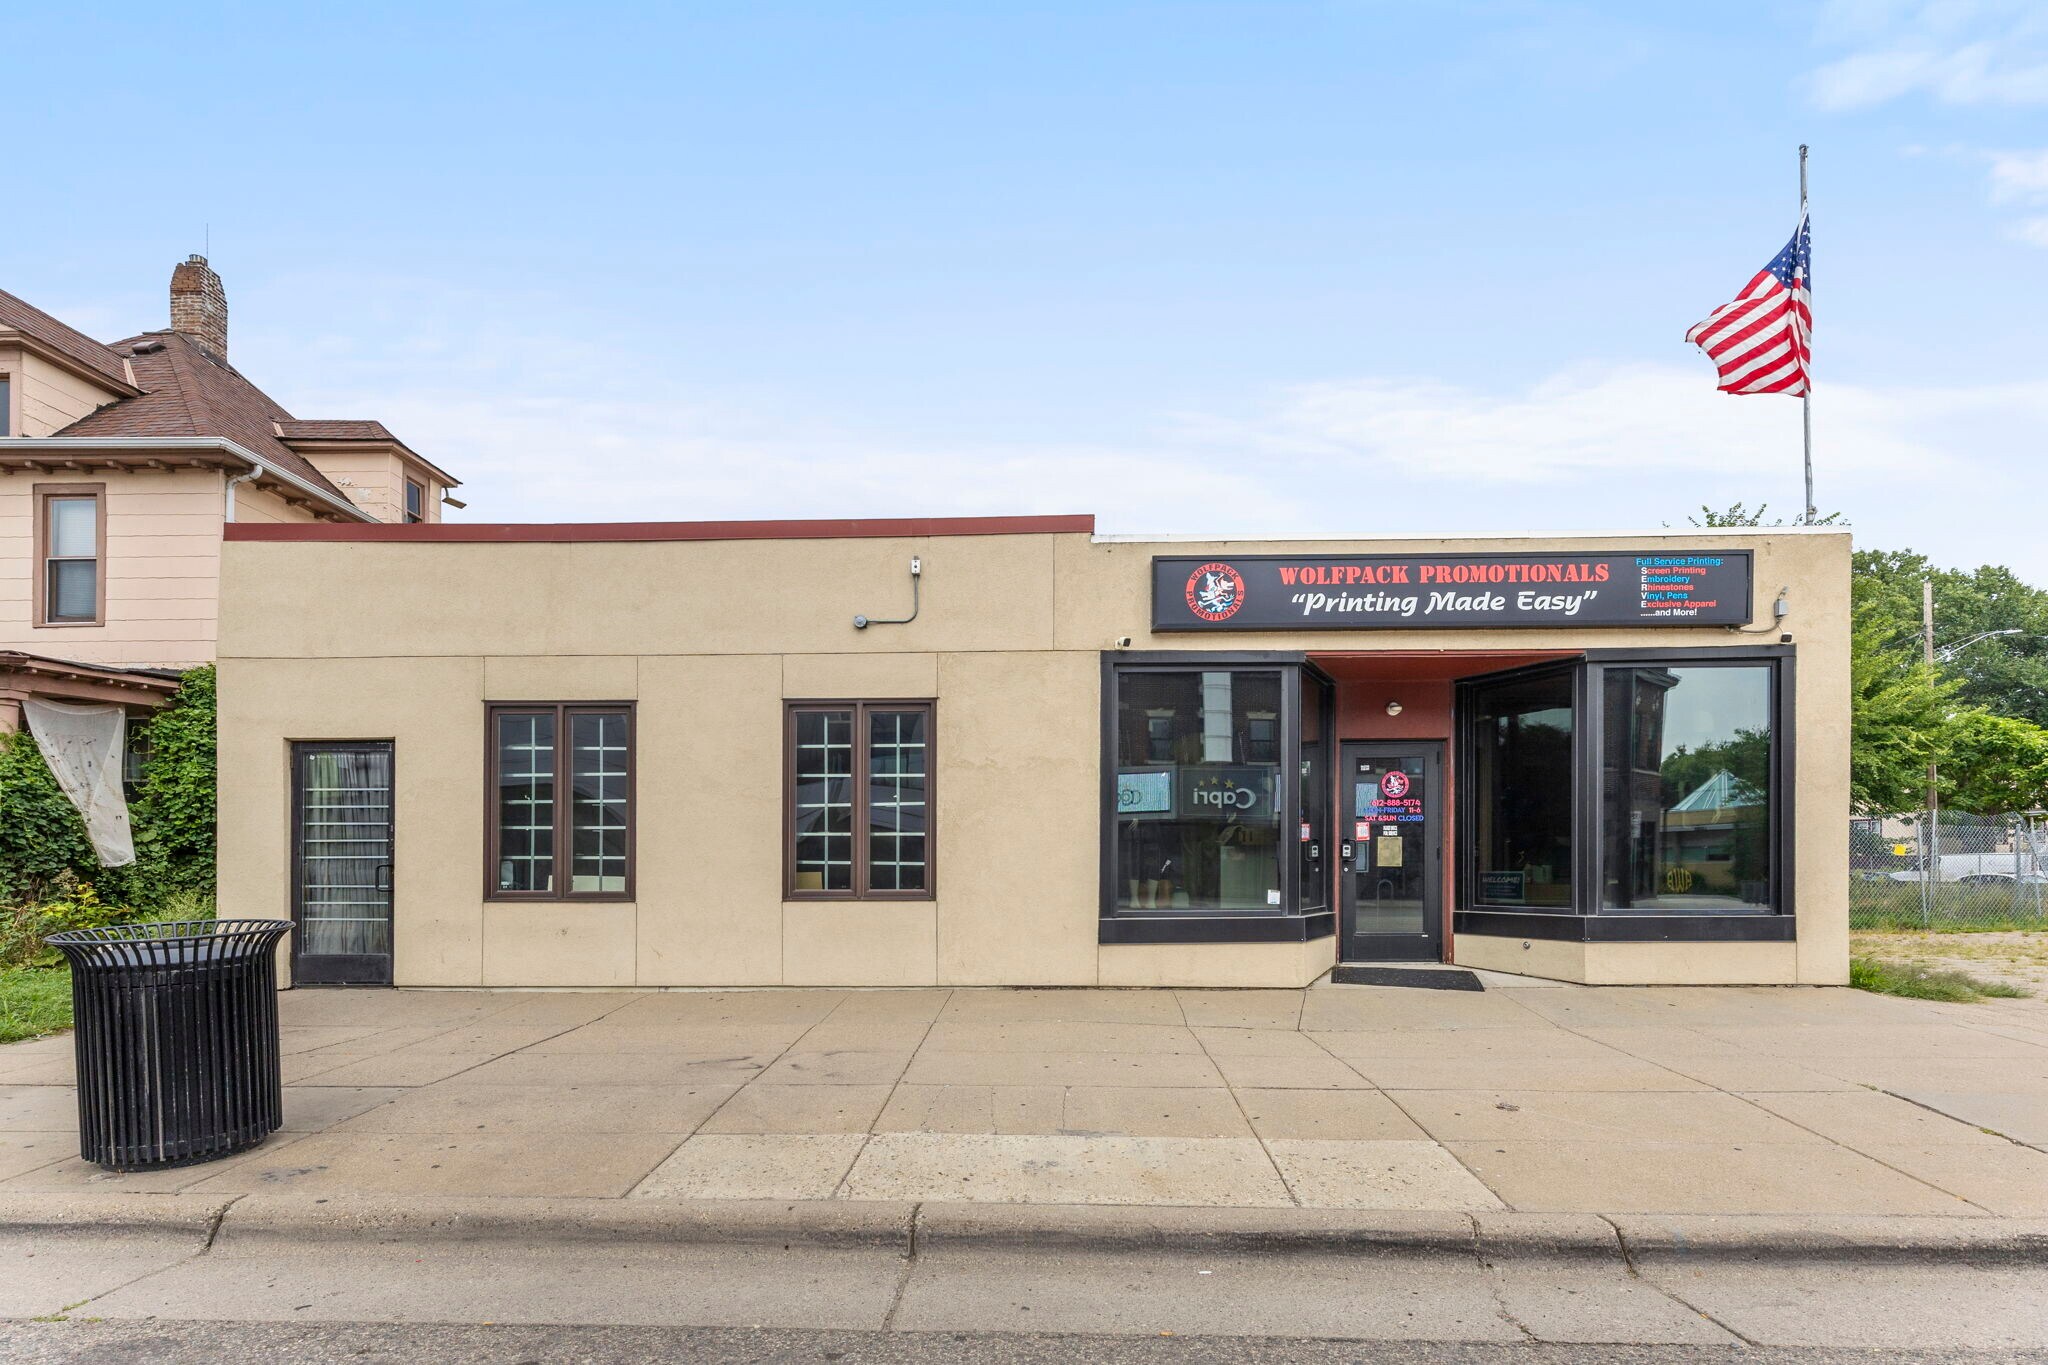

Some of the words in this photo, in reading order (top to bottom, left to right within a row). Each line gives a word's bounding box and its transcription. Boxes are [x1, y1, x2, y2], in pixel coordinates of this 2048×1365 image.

[1635, 557, 1652, 566] Full
[1654, 557, 1686, 566] Service
[1687, 556, 1724, 567] Printing:
[1190, 563, 1240, 581] WOLFPACK
[1278, 565, 1410, 585] WOLFPACK
[1419, 563, 1610, 584] PROMOTIONALS
[1641, 566, 1671, 575] Screen
[1672, 566, 1707, 576] Printing
[1641, 575, 1690, 584] Embroidery
[1641, 584, 1694, 592] Rhinestones
[1641, 592, 1665, 601] Vinyl,
[1667, 592, 1688, 600] Pens
[1186, 590, 1244, 621] PROMOTIONALS
[1291, 591, 1418, 617] “Printing
[1424, 591, 1506, 615] Made
[1517, 590, 1598, 616] Easy”
[1640, 600, 1682, 609] Exclusive
[1683, 600, 1717, 610] Apparel
[1673, 608, 1698, 617] More!
